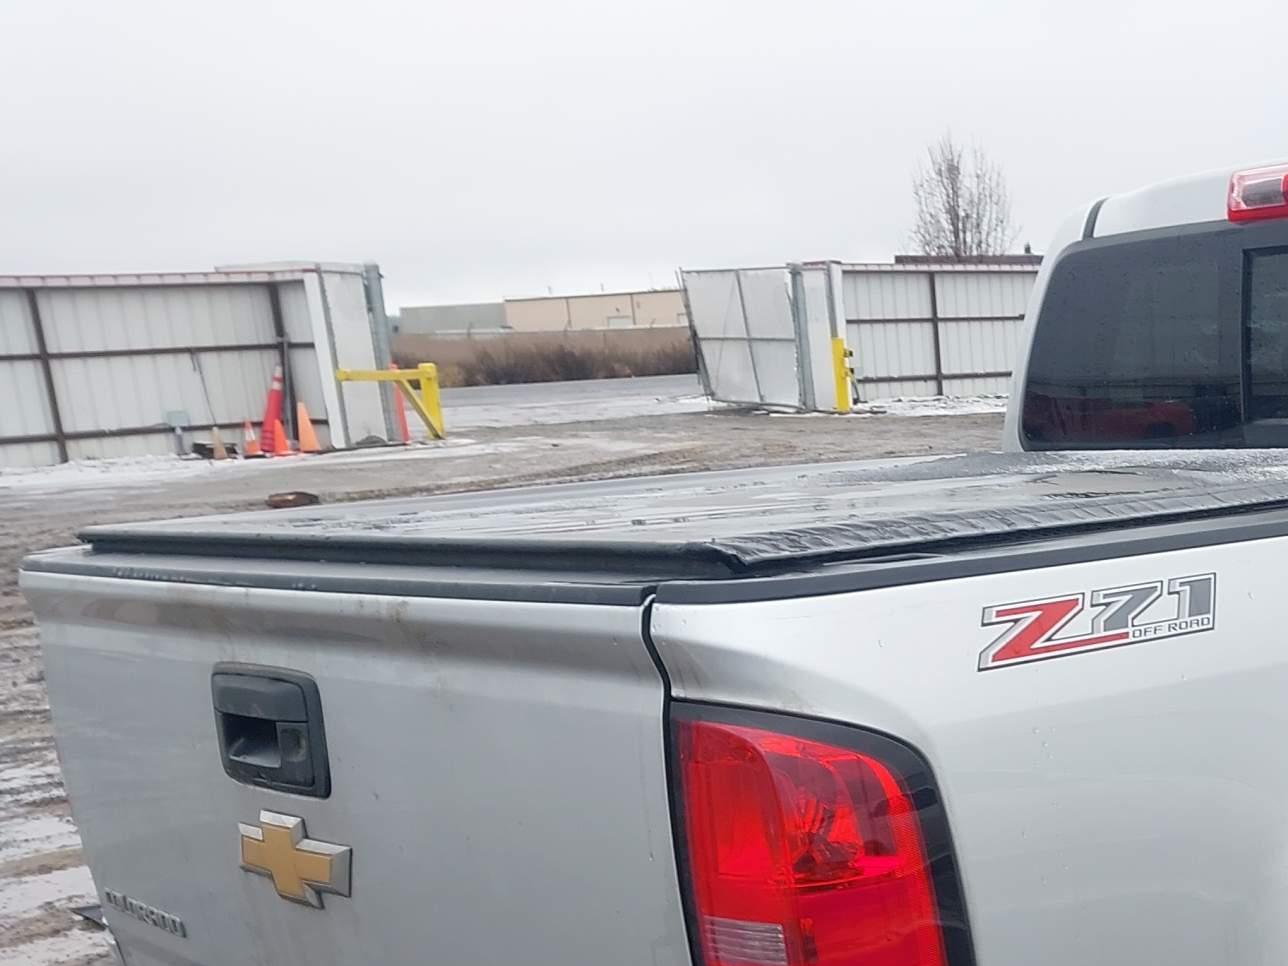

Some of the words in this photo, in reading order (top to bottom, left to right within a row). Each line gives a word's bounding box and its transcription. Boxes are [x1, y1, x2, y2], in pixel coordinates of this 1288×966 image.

[977, 572, 1216, 672] Z71
[1132, 625, 1163, 639] OFF
[1167, 616, 1211, 633] ROAD
